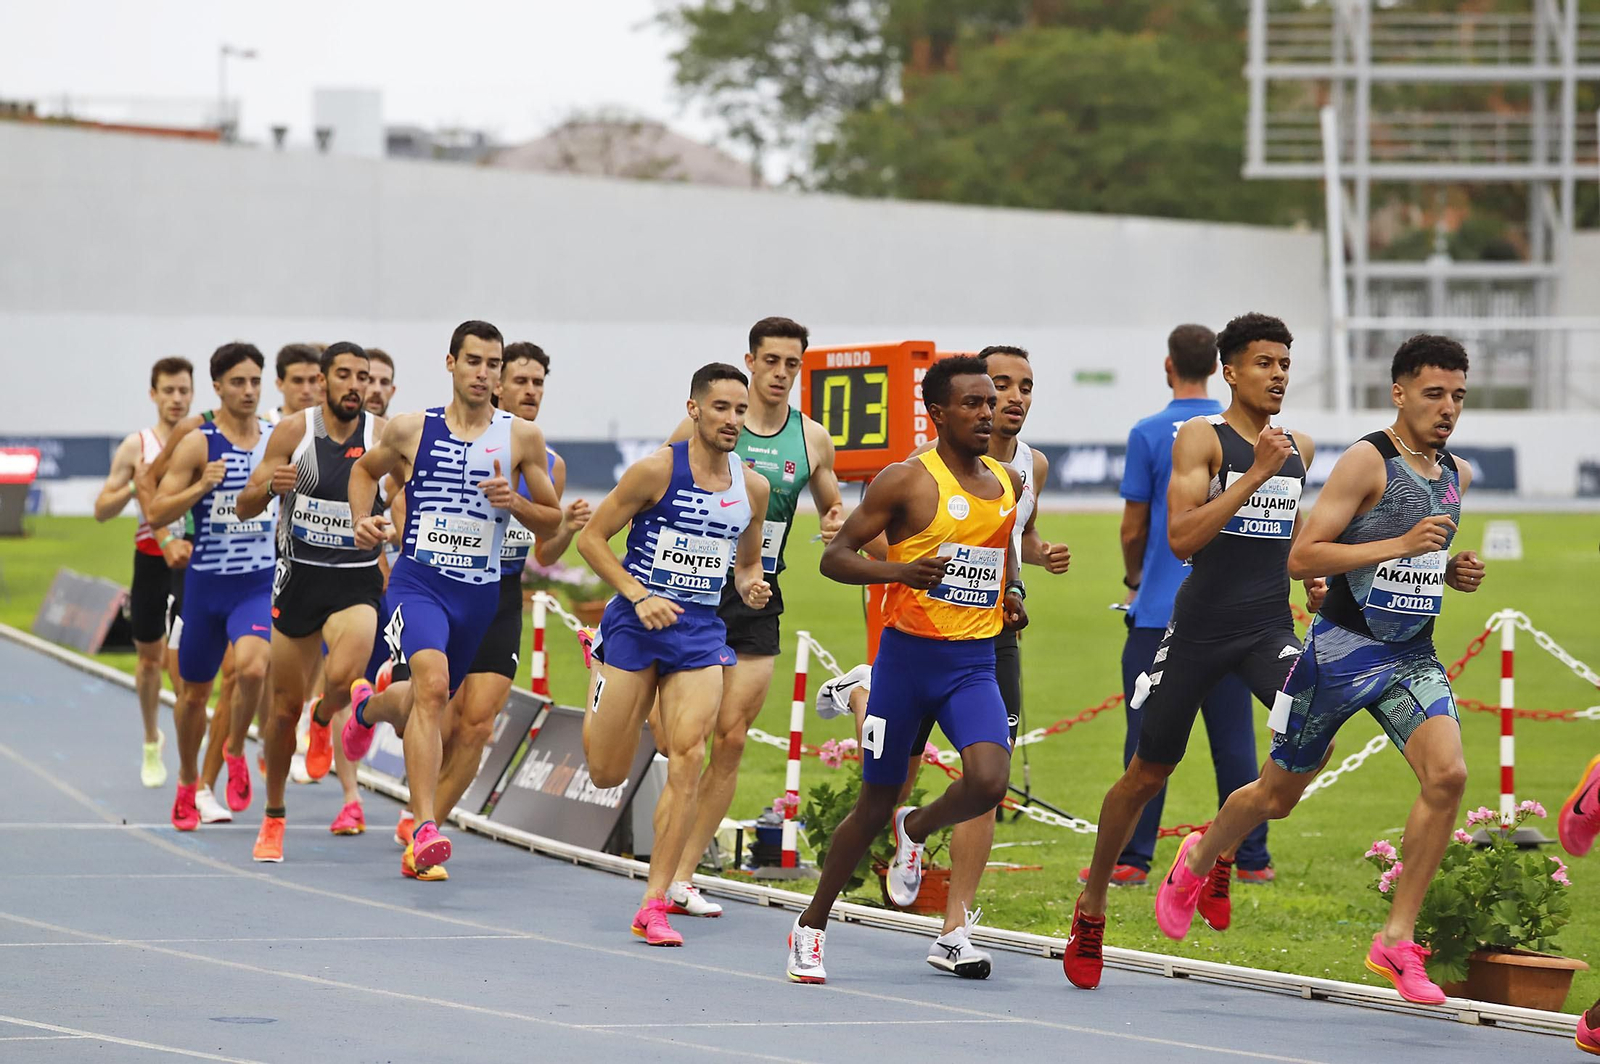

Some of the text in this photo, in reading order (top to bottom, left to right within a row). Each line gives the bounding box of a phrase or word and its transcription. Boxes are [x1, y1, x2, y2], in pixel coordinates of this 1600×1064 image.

[826, 351, 871, 367] MONDO
[823, 373, 888, 446] 03
[294, 510, 354, 529] ORDONE
[1264, 510, 1270, 518] 8
[1239, 519, 1282, 534] Joma
[304, 530, 343, 545] Joma
[428, 532, 482, 548] GOMEZ
[452, 545, 458, 553] 2
[430, 552, 473, 567] Joma
[662, 550, 721, 569] FONTES
[691, 566, 698, 575] 3
[945, 563, 997, 581] GADISA
[666, 573, 711, 589] Joma
[968, 580, 980, 588] 13
[944, 587, 988, 604] Joma
[1414, 585, 1421, 594] 6
[1387, 594, 1434, 610] Joma
